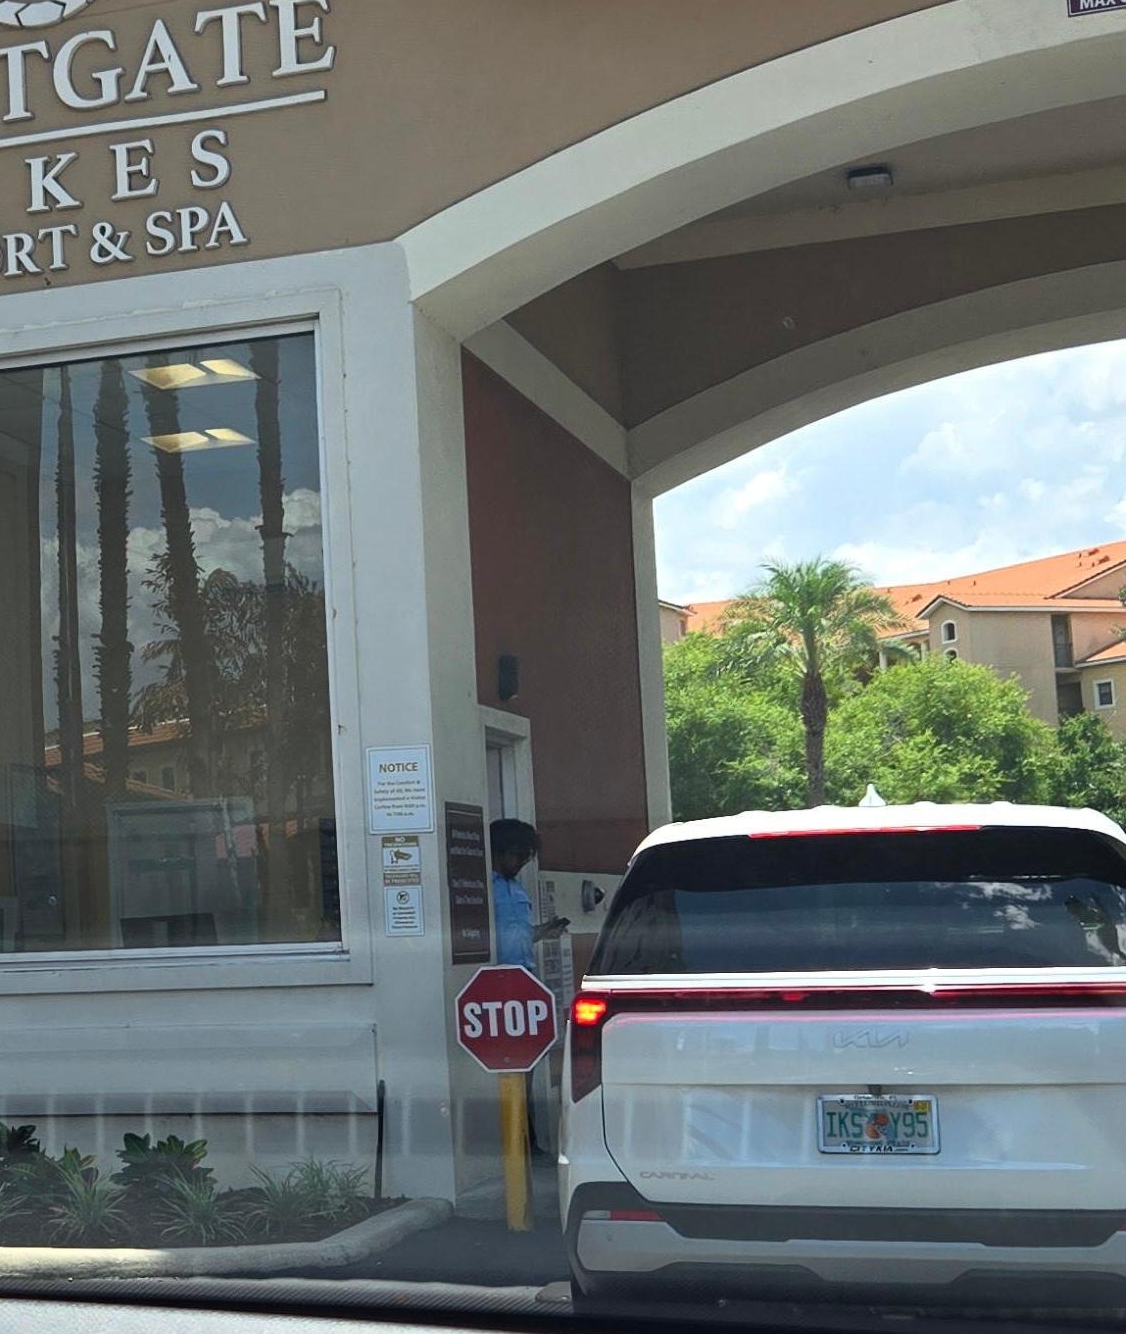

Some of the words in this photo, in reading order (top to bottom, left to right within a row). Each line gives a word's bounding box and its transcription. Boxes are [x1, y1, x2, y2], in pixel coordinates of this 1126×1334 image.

[89, 221, 134, 265] &
[145, 201, 249, 258] SPA
[378, 762, 419, 774] NOTICE
[462, 999, 549, 1039] STOP
